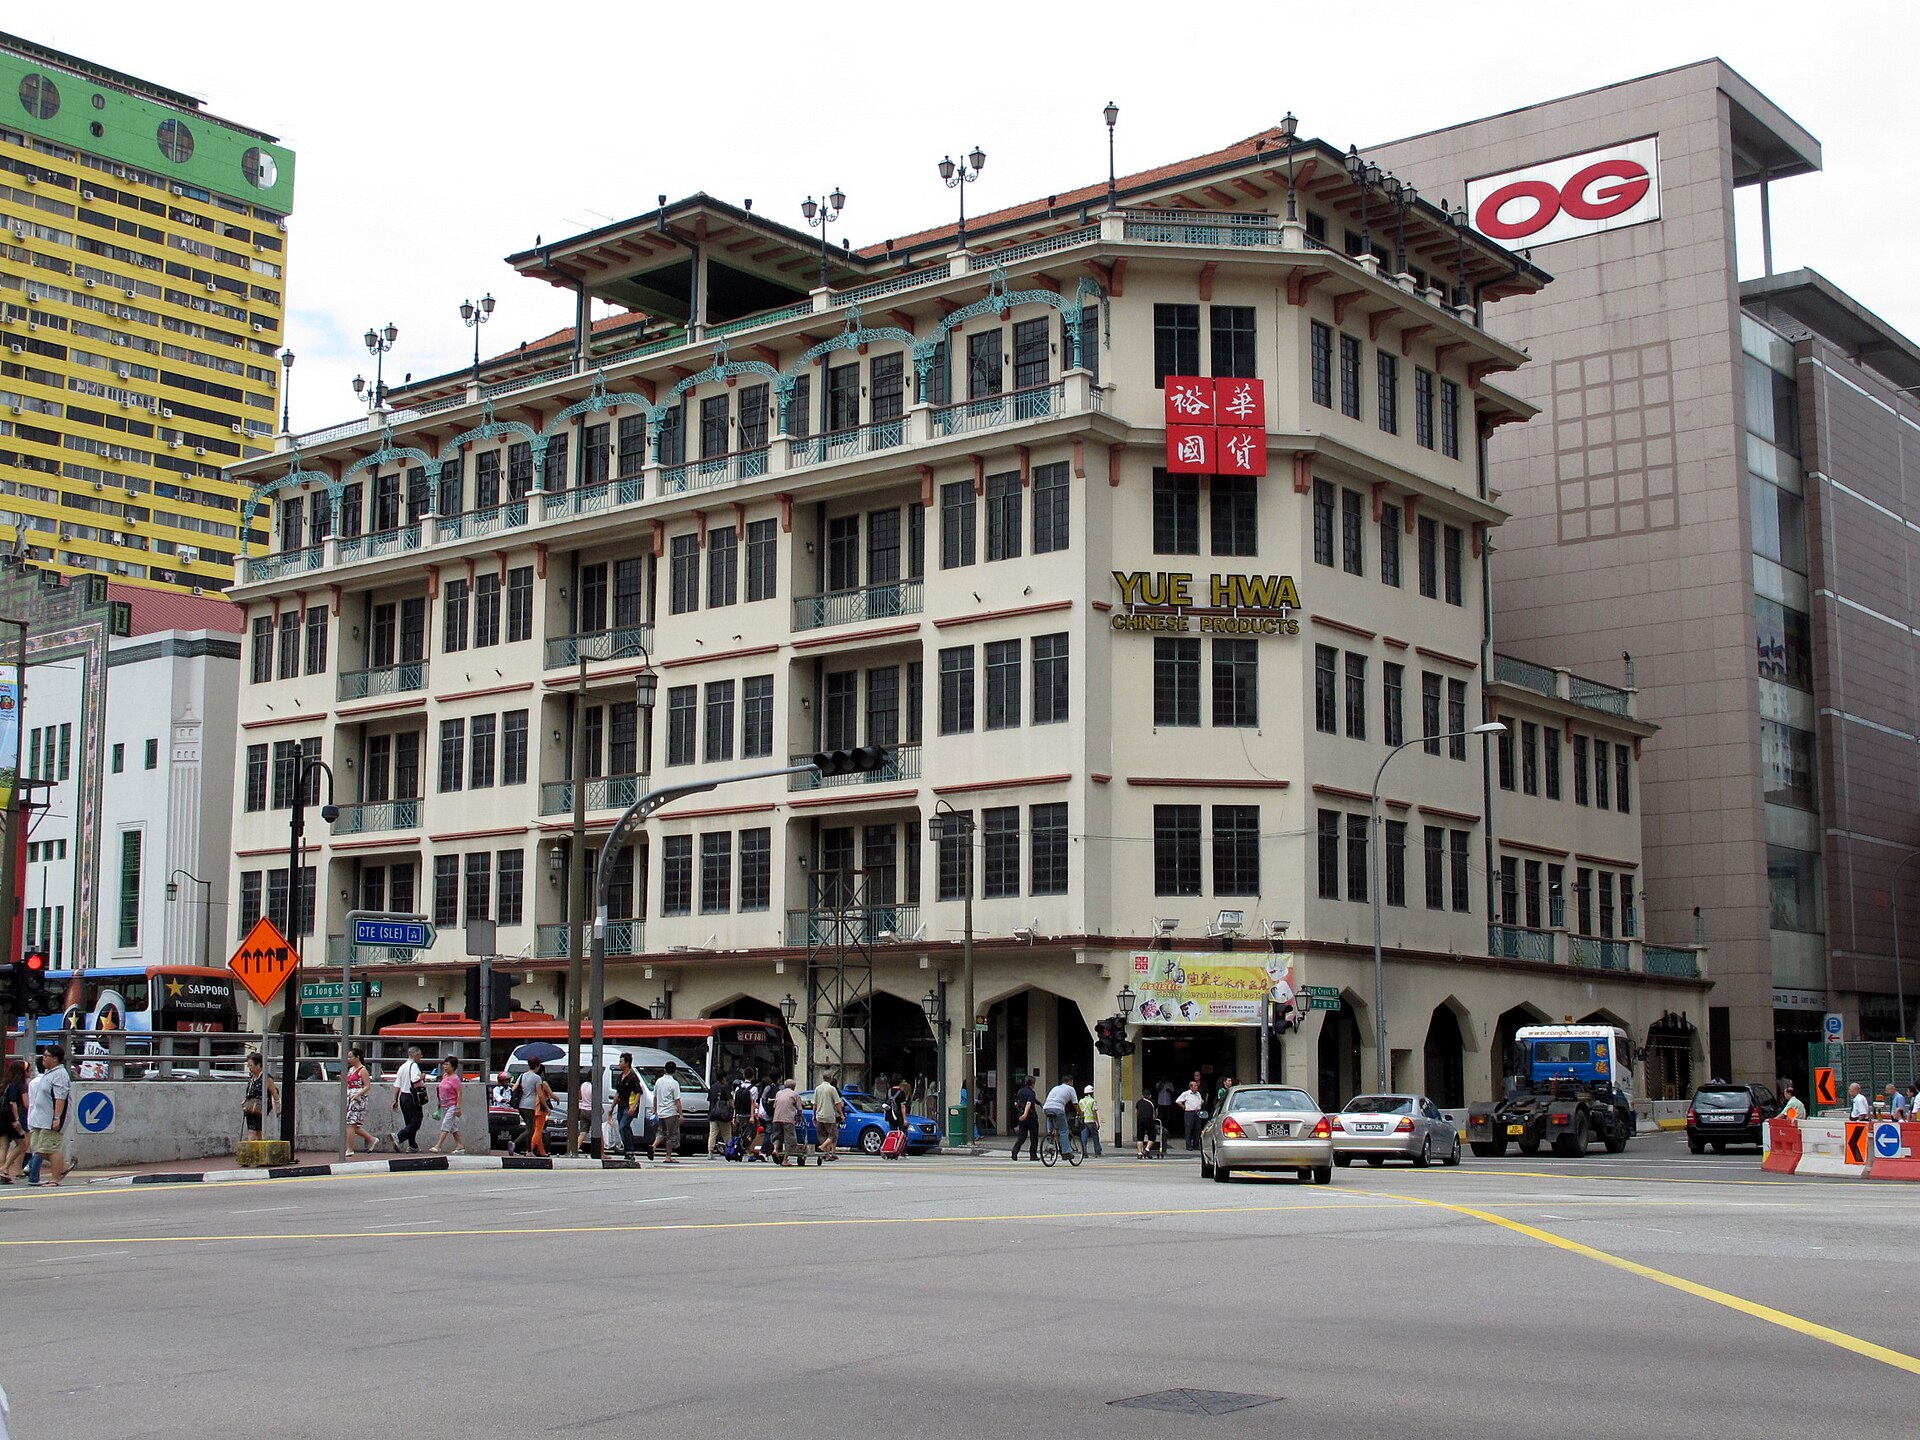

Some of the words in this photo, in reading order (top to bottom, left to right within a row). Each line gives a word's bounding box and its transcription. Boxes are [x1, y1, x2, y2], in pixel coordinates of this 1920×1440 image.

[1475, 159, 1650, 240] OG
[1170, 383, 1257, 421] 裕華
[1177, 433, 1257, 470] 國貨
[1111, 571, 1193, 607] YUE
[1210, 574, 1301, 609] HWA
[1112, 614, 1189, 632] CHINESE
[1200, 617, 1300, 634] PRODUCTS
[359, 926, 375, 938] CTE
[380, 926, 403, 939] (SLE)
[188, 984, 230, 997] SAPPORO
[303, 986, 313, 996] Eu
[315, 985, 332, 998] Tong
[335, 984, 344, 995] Se
[351, 984, 360, 994] St
[1140, 979, 1183, 991] Artistic
[1226, 990, 1263, 1000] Collecti
[175, 1000, 206, 1009] Premium
[206, 1001, 222, 1010] Beer
[188, 1022, 213, 1033] 147
